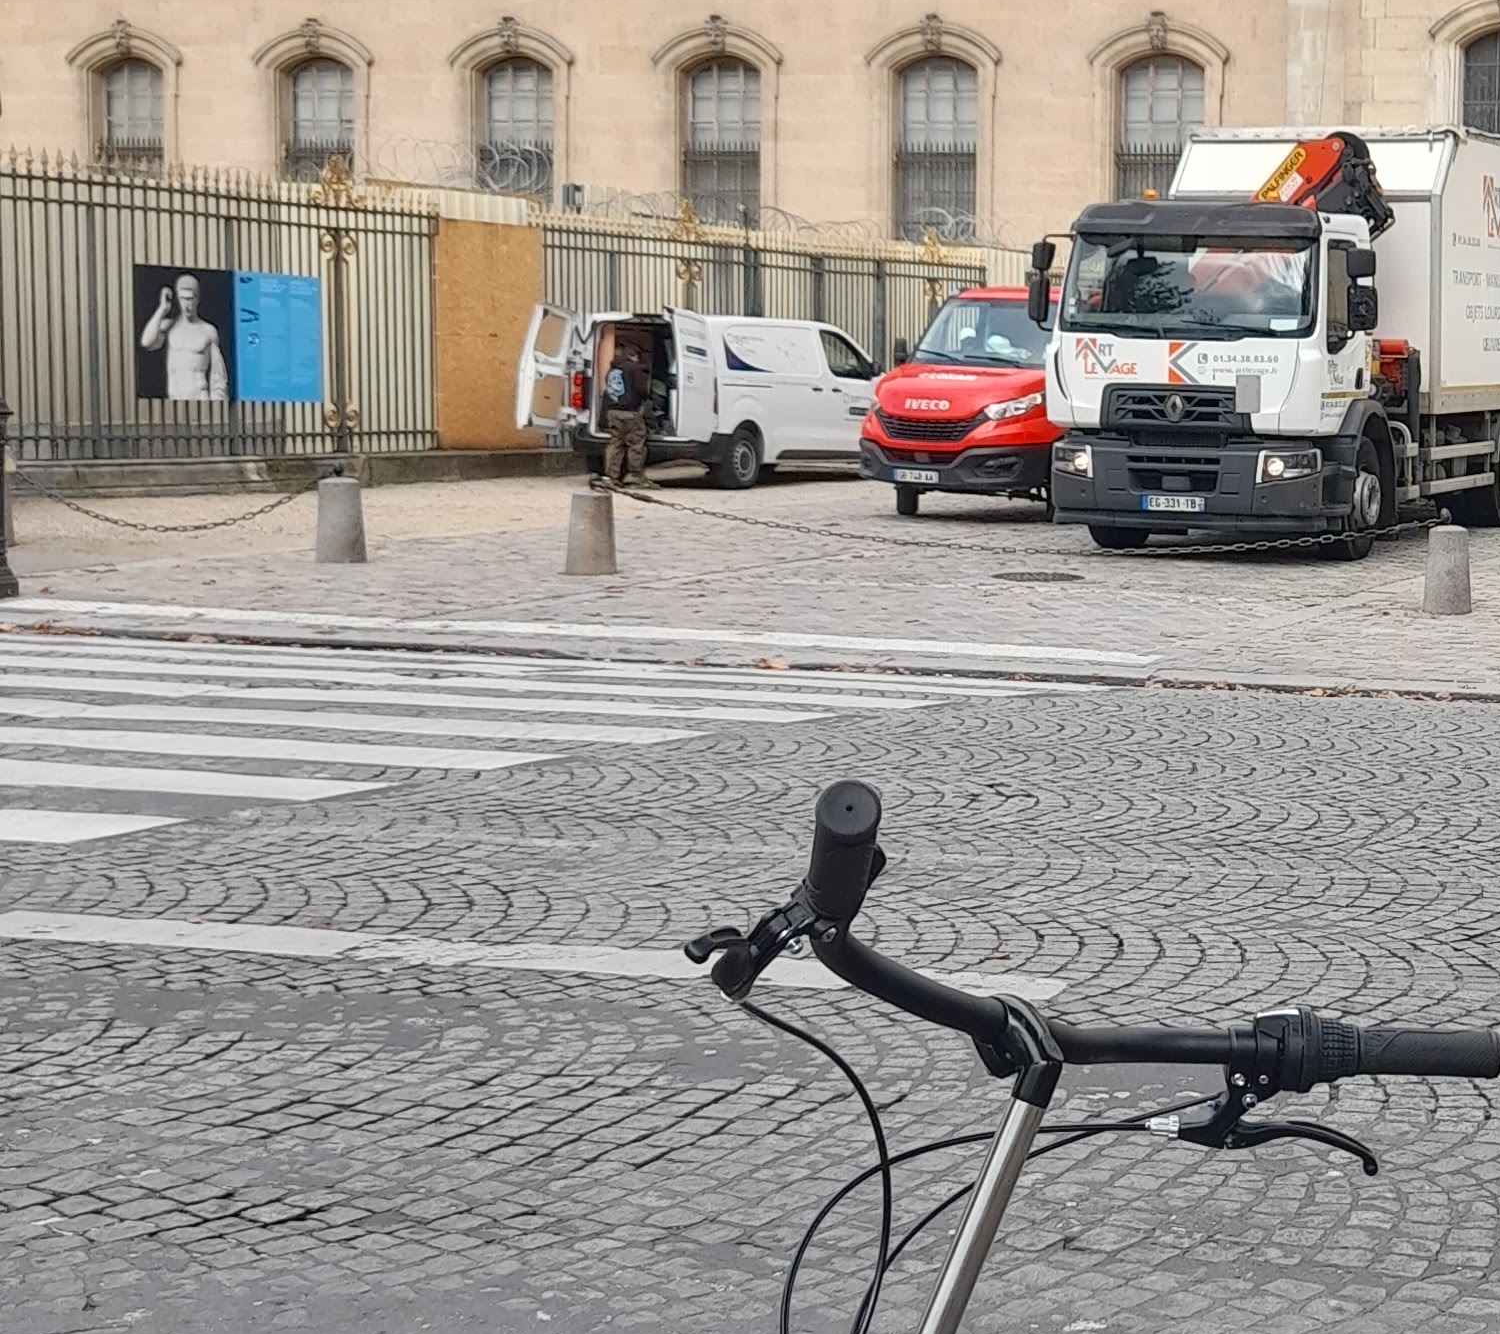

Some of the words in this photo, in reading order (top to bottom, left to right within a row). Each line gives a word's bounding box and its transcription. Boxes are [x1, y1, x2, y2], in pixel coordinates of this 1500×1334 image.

[1261, 151, 1304, 199] PALFINGER
[1452, 270, 1482, 287] TRANSPORT
[904, 398, 951, 411] IVECO
